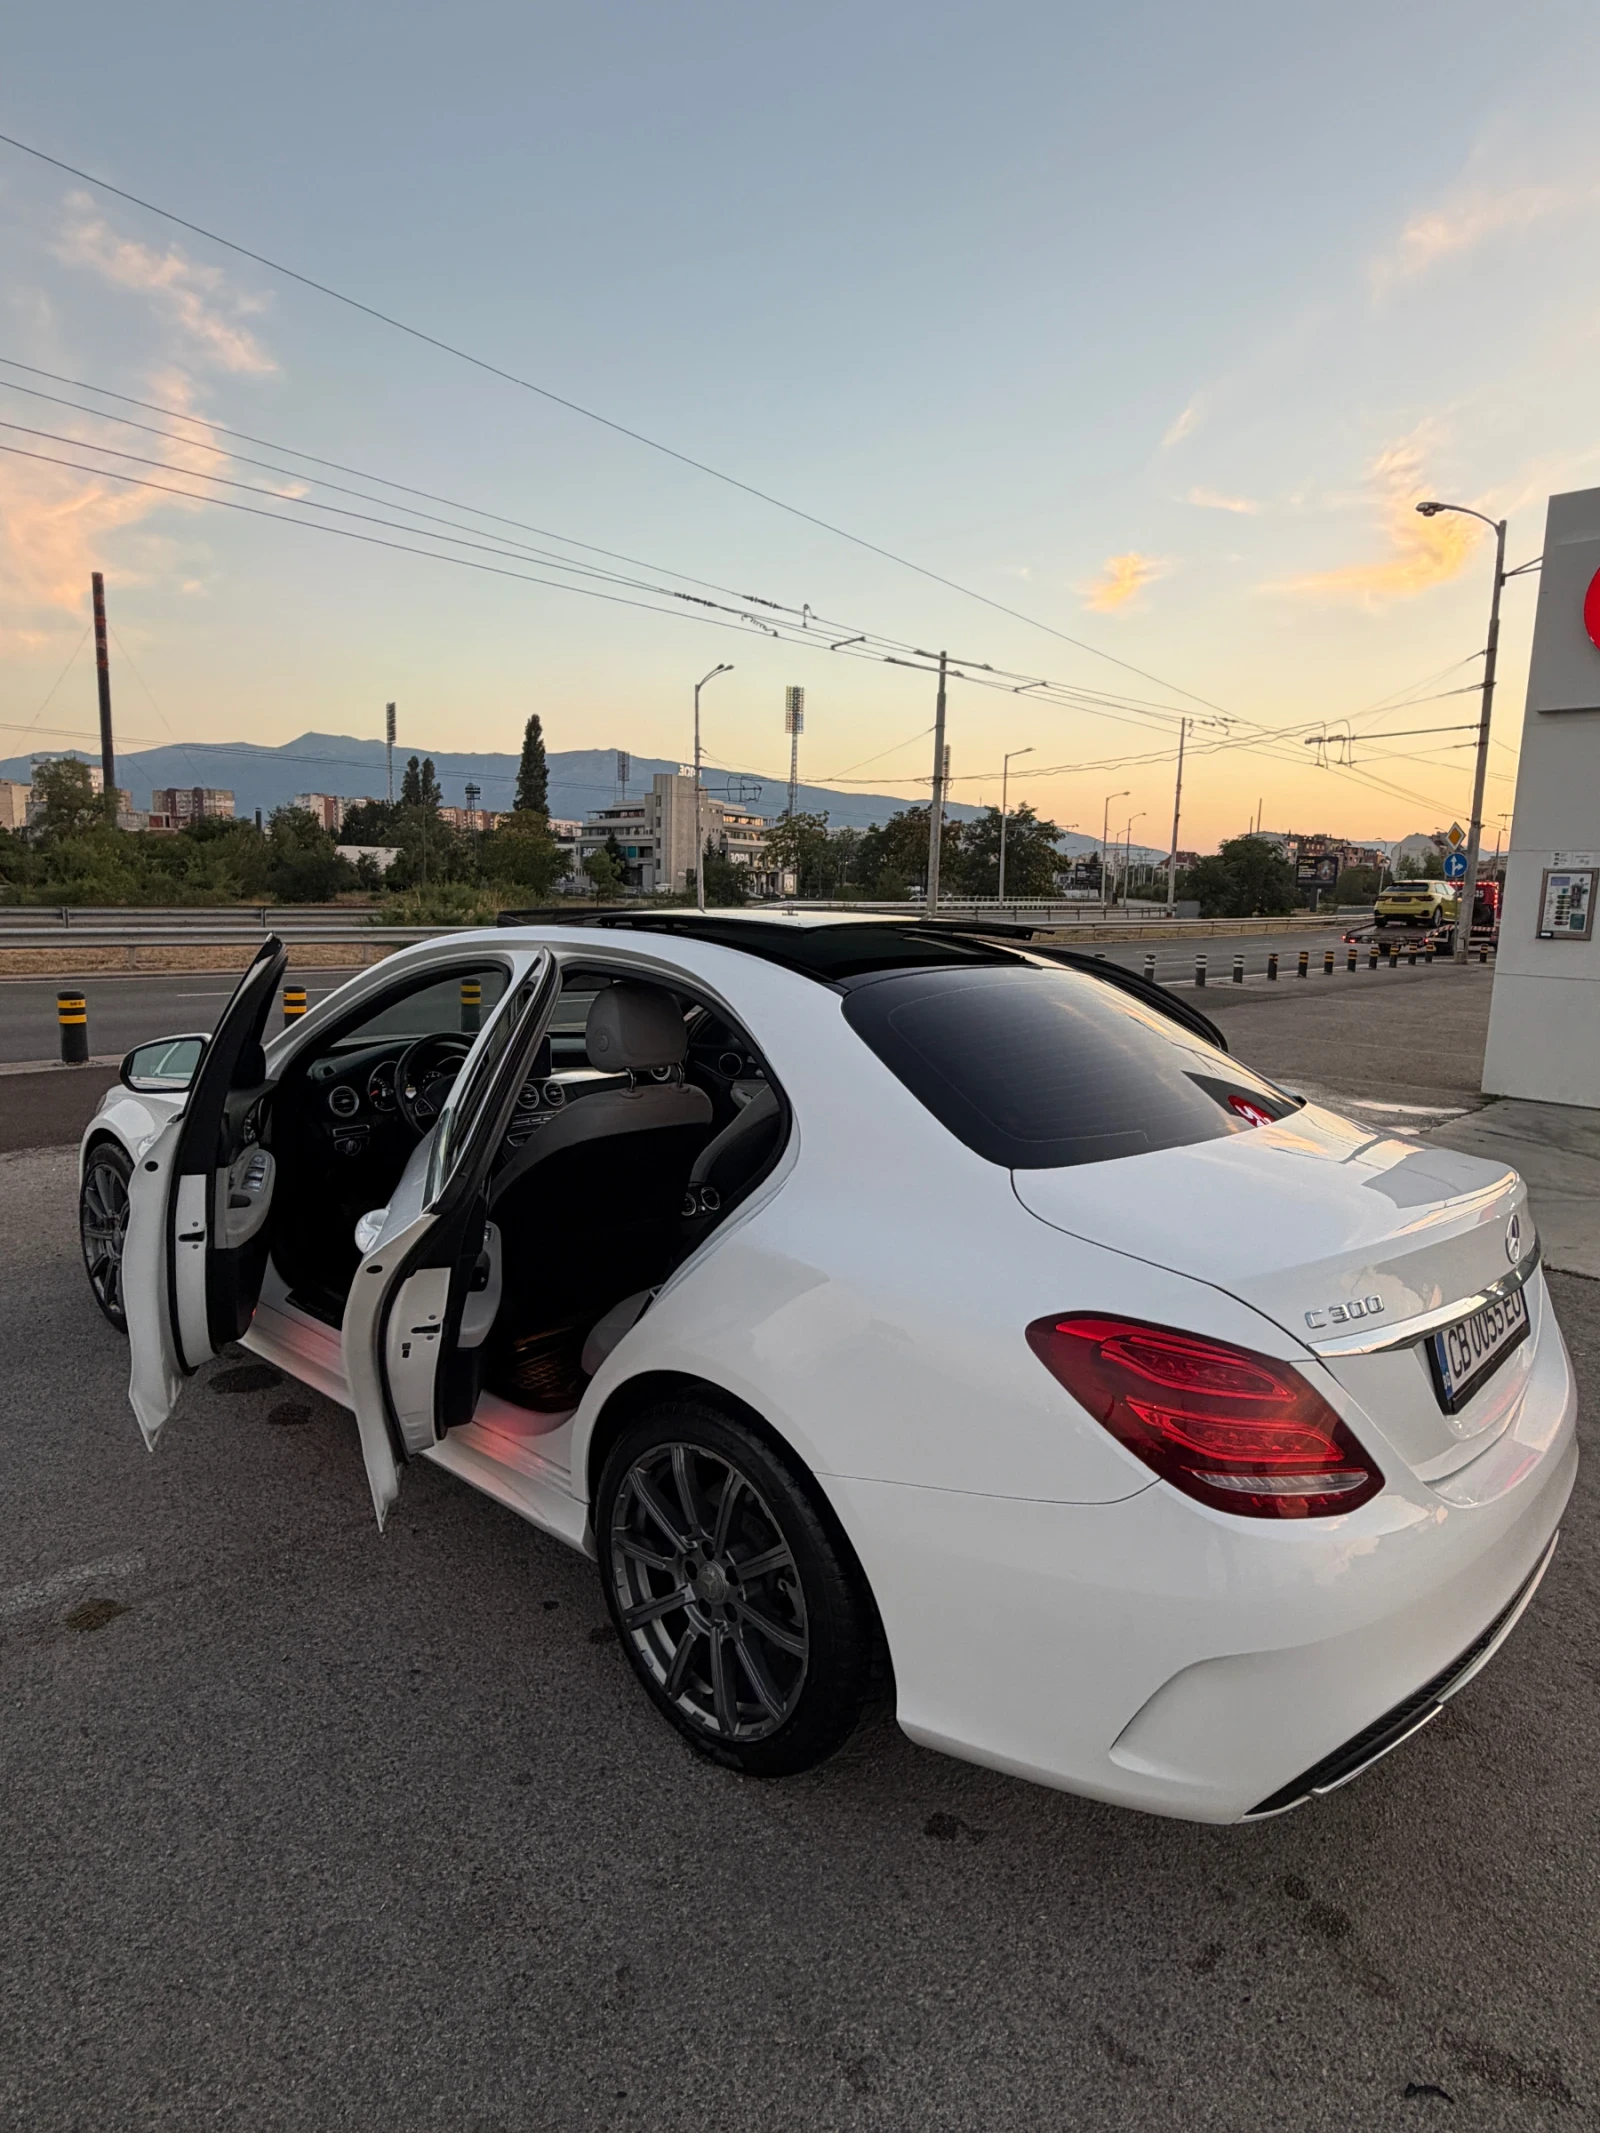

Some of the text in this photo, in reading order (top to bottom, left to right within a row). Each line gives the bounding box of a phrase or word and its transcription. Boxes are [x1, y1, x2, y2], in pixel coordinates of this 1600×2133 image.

[1304, 1294, 1385, 1330] C 300
[1448, 1324, 1472, 1379] CB
